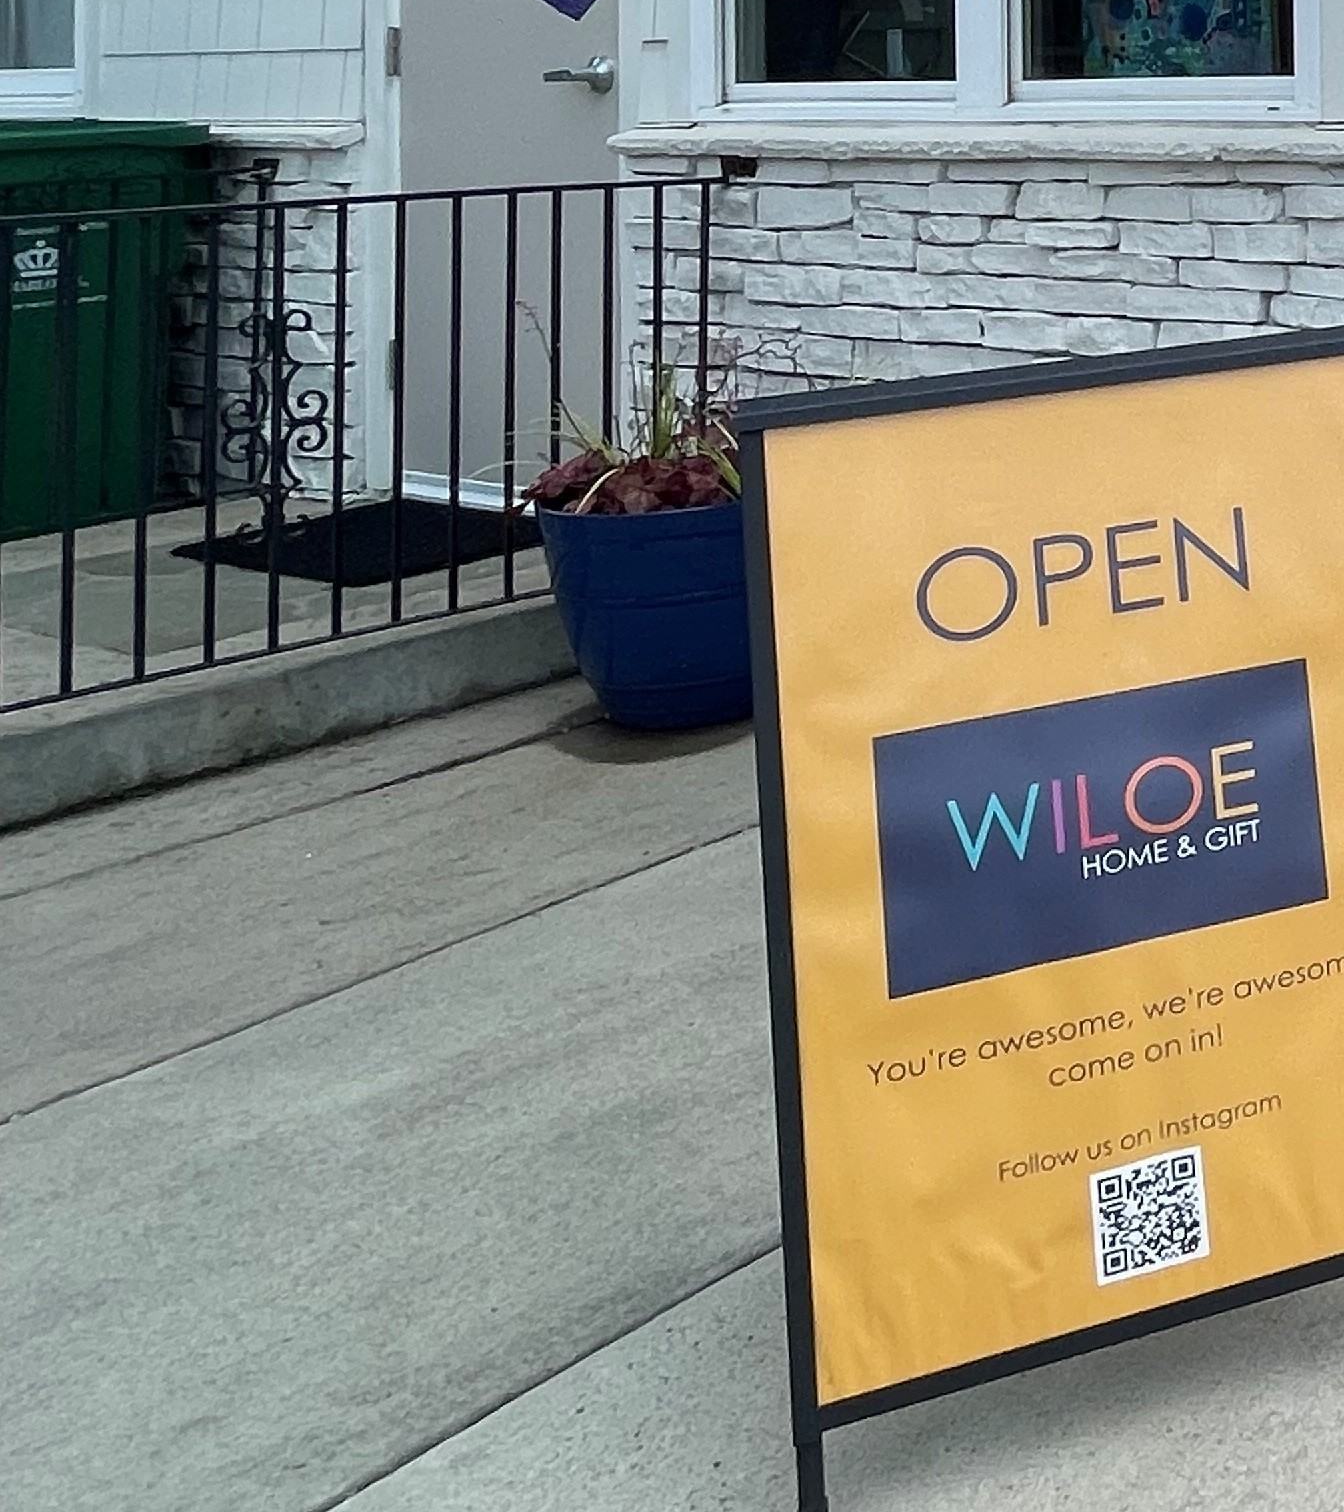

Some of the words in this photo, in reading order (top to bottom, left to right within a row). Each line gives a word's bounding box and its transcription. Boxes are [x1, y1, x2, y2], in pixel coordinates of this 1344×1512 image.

[916, 506, 1250, 642] OPEN
[947, 740, 1259, 871] WILOE
[1082, 839, 1169, 879] HOME
[1176, 835, 1198, 858] &
[1204, 819, 1260, 851] GIFT
[866, 1048, 968, 1087] You're
[978, 1008, 1134, 1061] awesome,
[1142, 987, 1225, 1018] we're
[1048, 1049, 1136, 1088] come
[1144, 1035, 1182, 1064] on
[1190, 1024, 1225, 1054] in!
[997, 1146, 1079, 1182] Follow
[1086, 1138, 1113, 1160] us
[1119, 1126, 1152, 1152] on
[1158, 1092, 1283, 1140] Instagram
